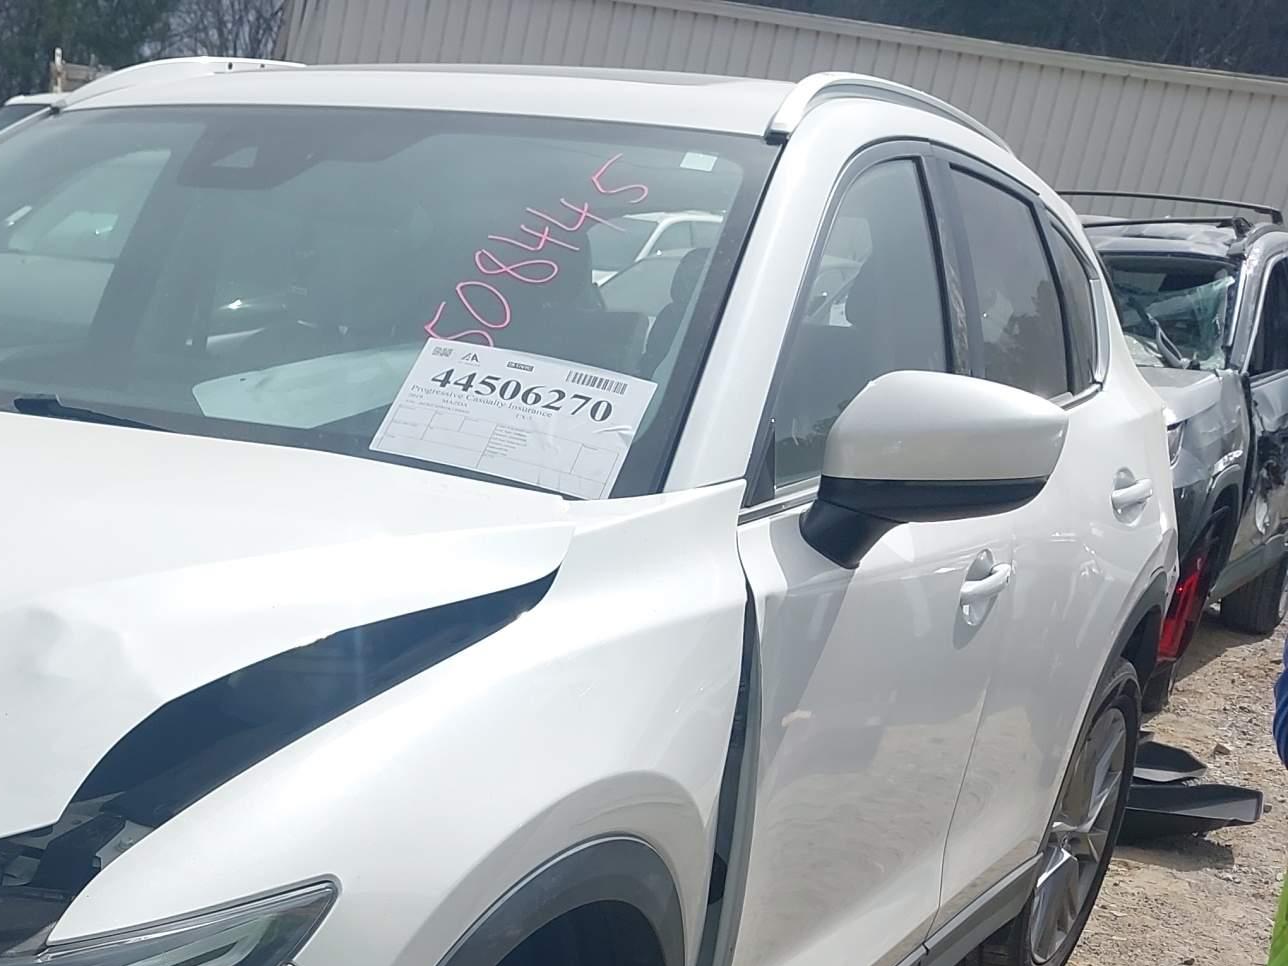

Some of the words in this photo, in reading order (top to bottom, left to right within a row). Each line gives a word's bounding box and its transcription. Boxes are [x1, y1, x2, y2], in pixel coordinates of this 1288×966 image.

[424, 152, 648, 348] 508445
[410, 384, 464, 400] Progressive
[466, 394, 505, 408] Casualty
[508, 402, 553, 418] Insurance
[430, 368, 614, 422] 44506270
